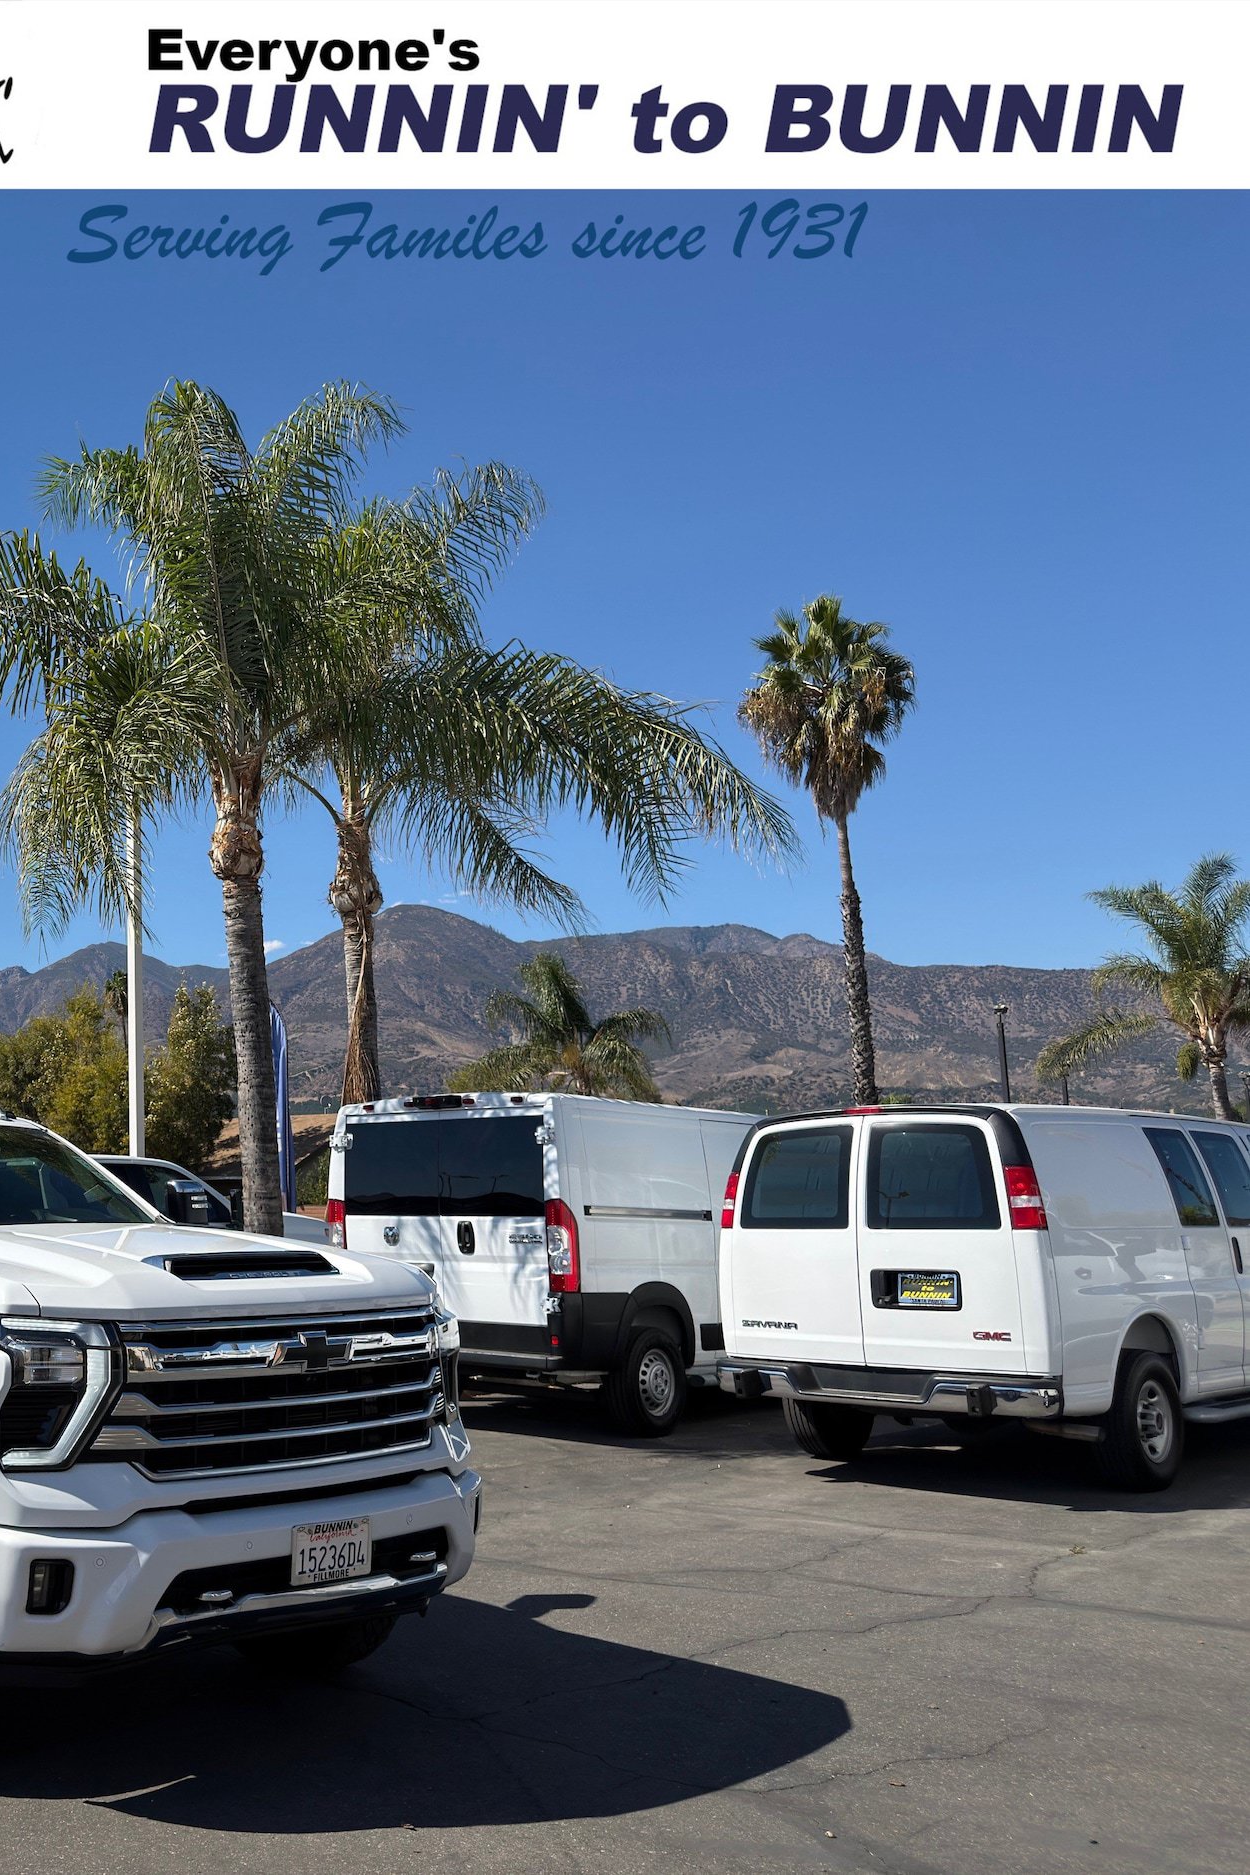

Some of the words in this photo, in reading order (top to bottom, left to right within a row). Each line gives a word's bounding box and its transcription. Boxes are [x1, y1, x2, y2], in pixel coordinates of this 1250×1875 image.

[902, 1291, 952, 1299] BUNNIN
[742, 1319, 799, 1331] SAVANA
[973, 1331, 1012, 1342] GMC
[314, 1520, 354, 1535] BUNNIN
[298, 1540, 366, 1576] 15236D4
[313, 1568, 350, 1582] FILLMORE
